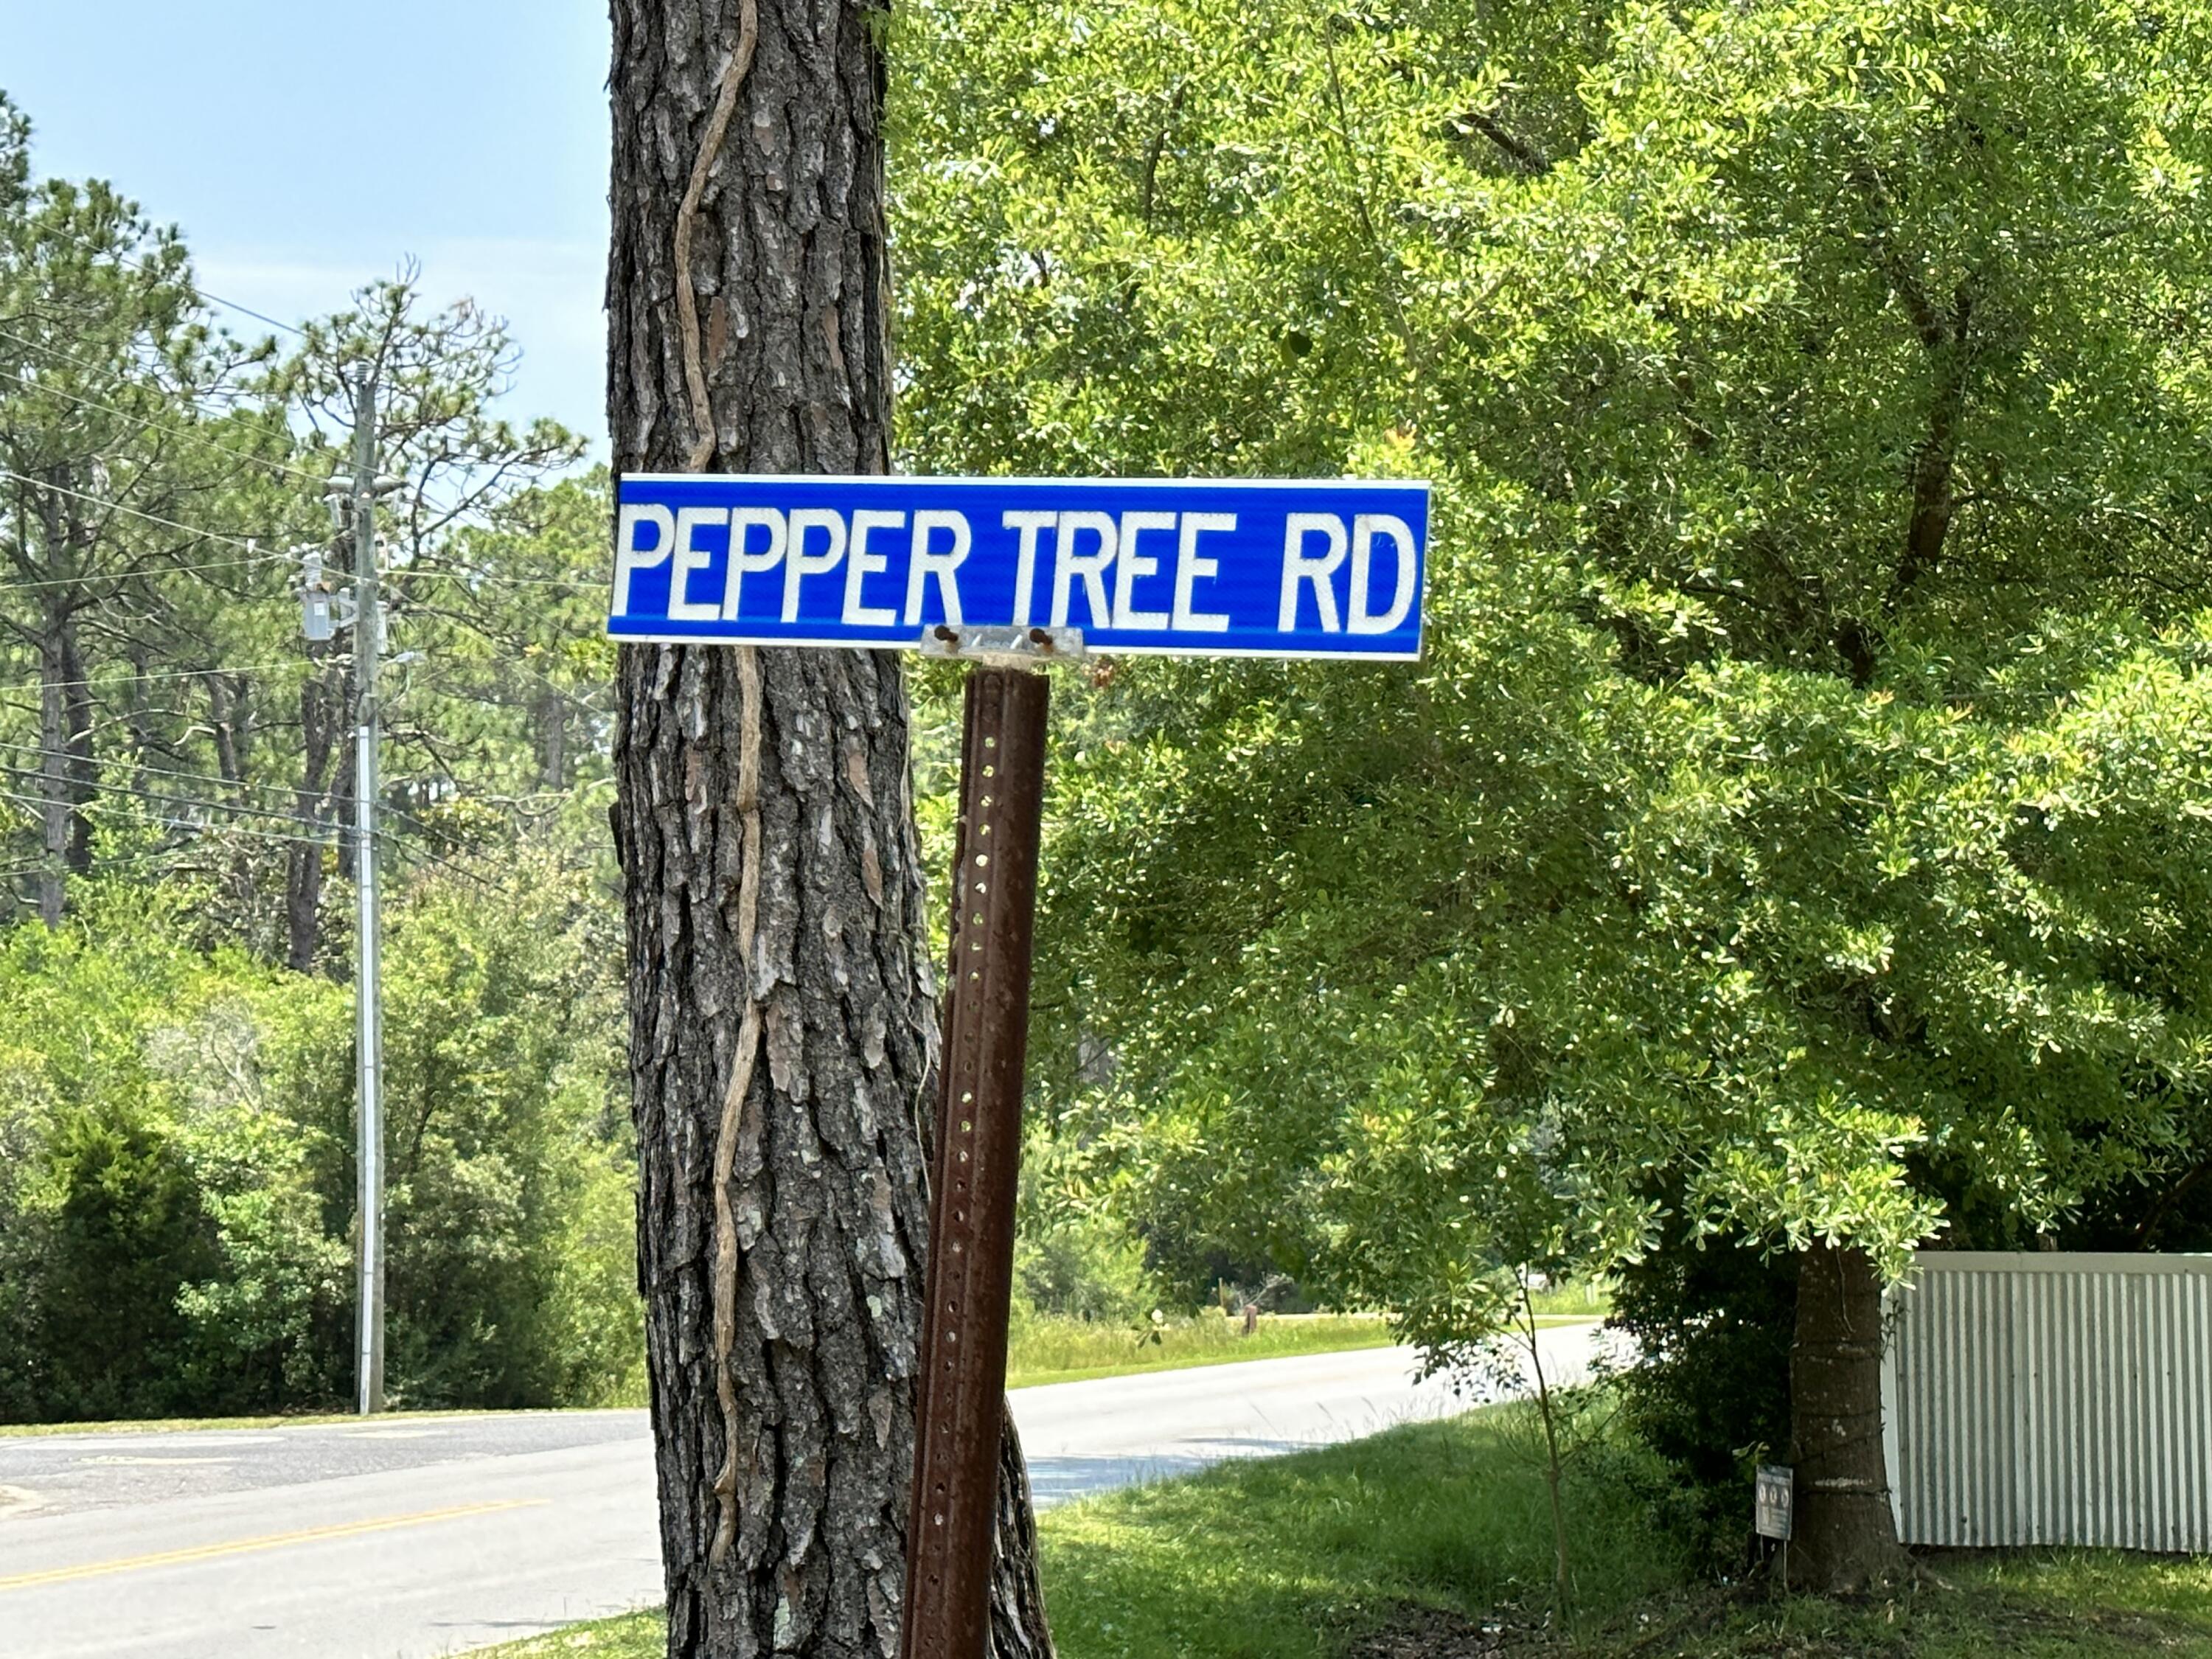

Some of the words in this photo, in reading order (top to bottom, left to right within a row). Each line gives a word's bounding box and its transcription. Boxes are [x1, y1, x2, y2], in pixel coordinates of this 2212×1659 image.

[611, 504, 972, 625] PEPPER
[1001, 510, 1237, 632] TREE
[1278, 512, 1416, 634] RD
